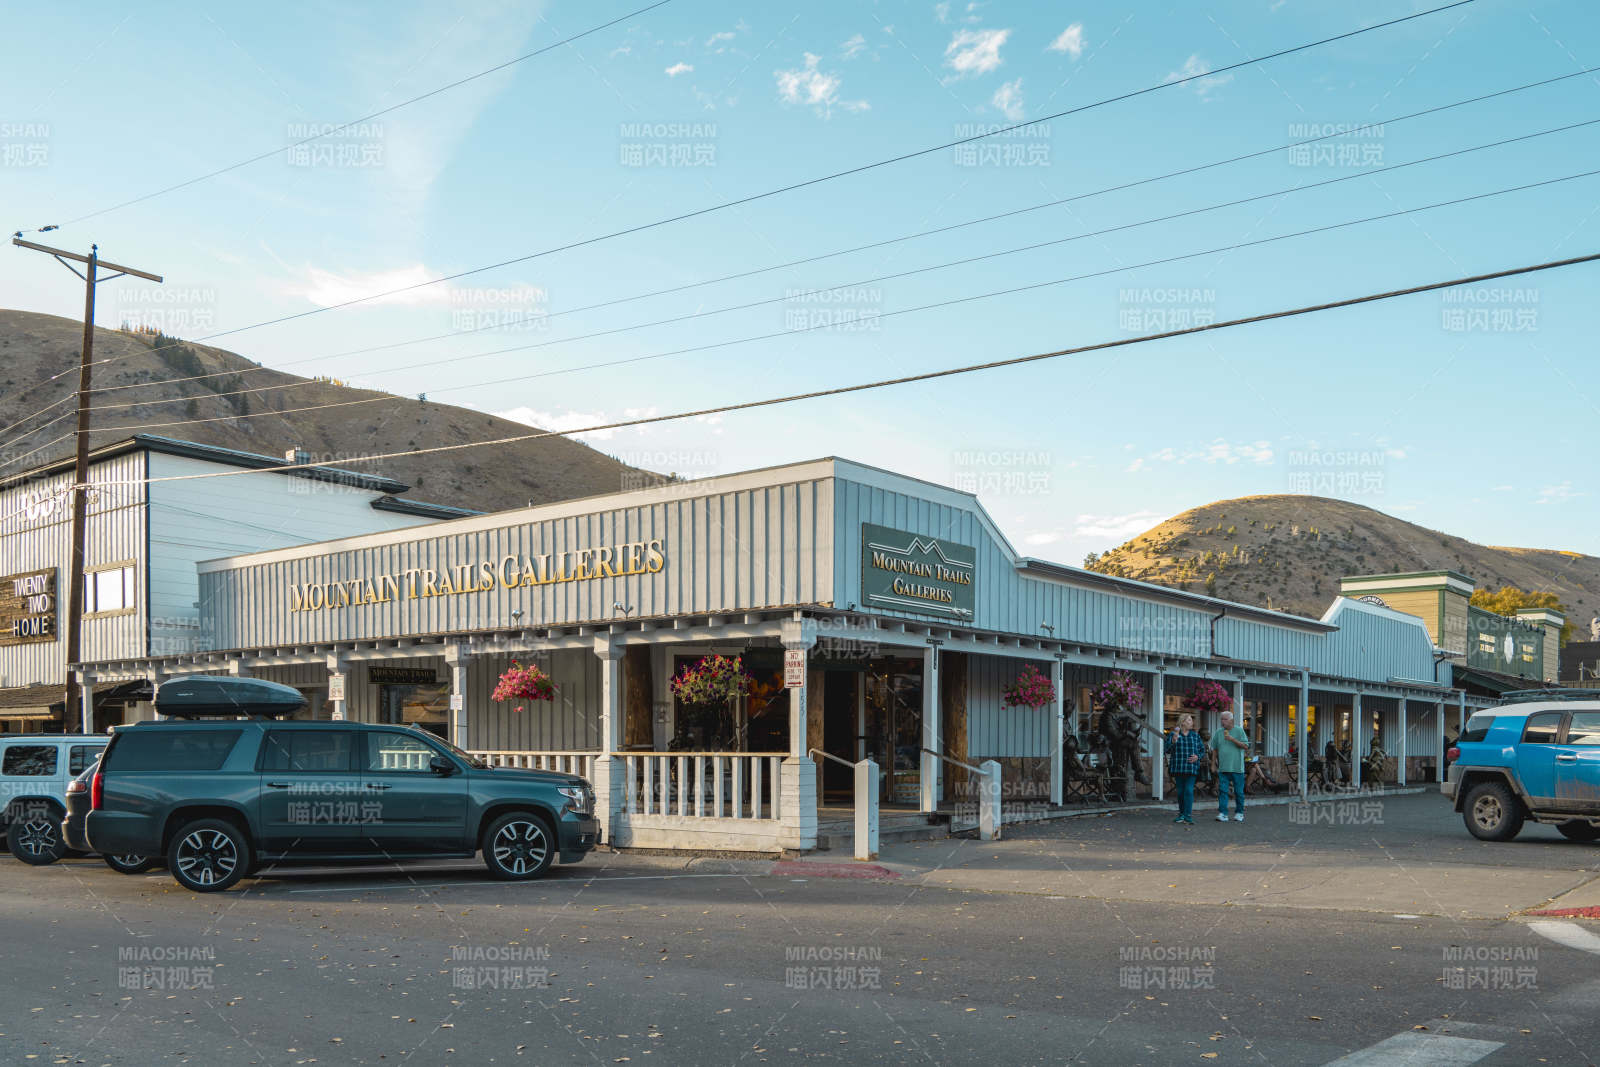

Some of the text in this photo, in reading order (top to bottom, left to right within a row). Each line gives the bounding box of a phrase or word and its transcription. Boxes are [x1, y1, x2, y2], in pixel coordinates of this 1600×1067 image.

[290, 539, 665, 613] MOUNTAIN TRAILS GALLERIES
[872, 551, 971, 585] MOUNTAIN TRAILS
[13, 573, 48, 597] TWENTY
[893, 577, 952, 603] GALLERIES
[28, 593, 48, 614] TWO
[13, 616, 49, 637] HOME
